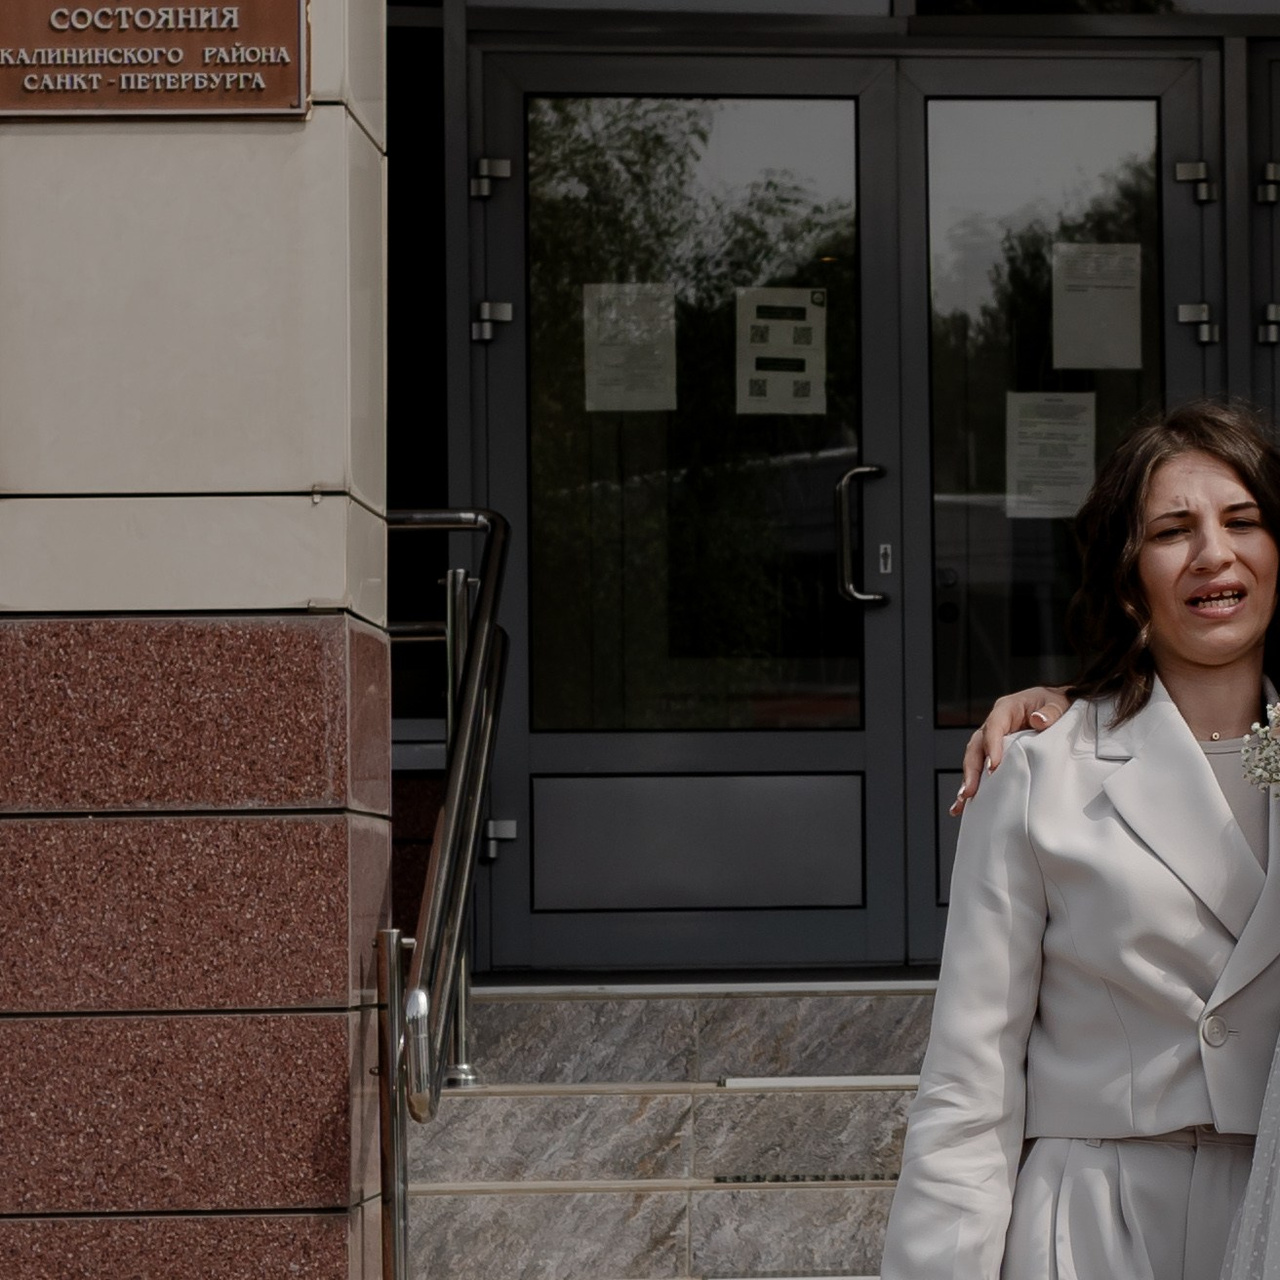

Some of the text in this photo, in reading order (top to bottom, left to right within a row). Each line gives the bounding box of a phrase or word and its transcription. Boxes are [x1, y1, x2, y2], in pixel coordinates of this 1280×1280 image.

[49, 6, 241, 31] СОСТОЯНИЯ
[0, 41, 292, 65] КАЛИНИНСКОГО РАЙОНА
